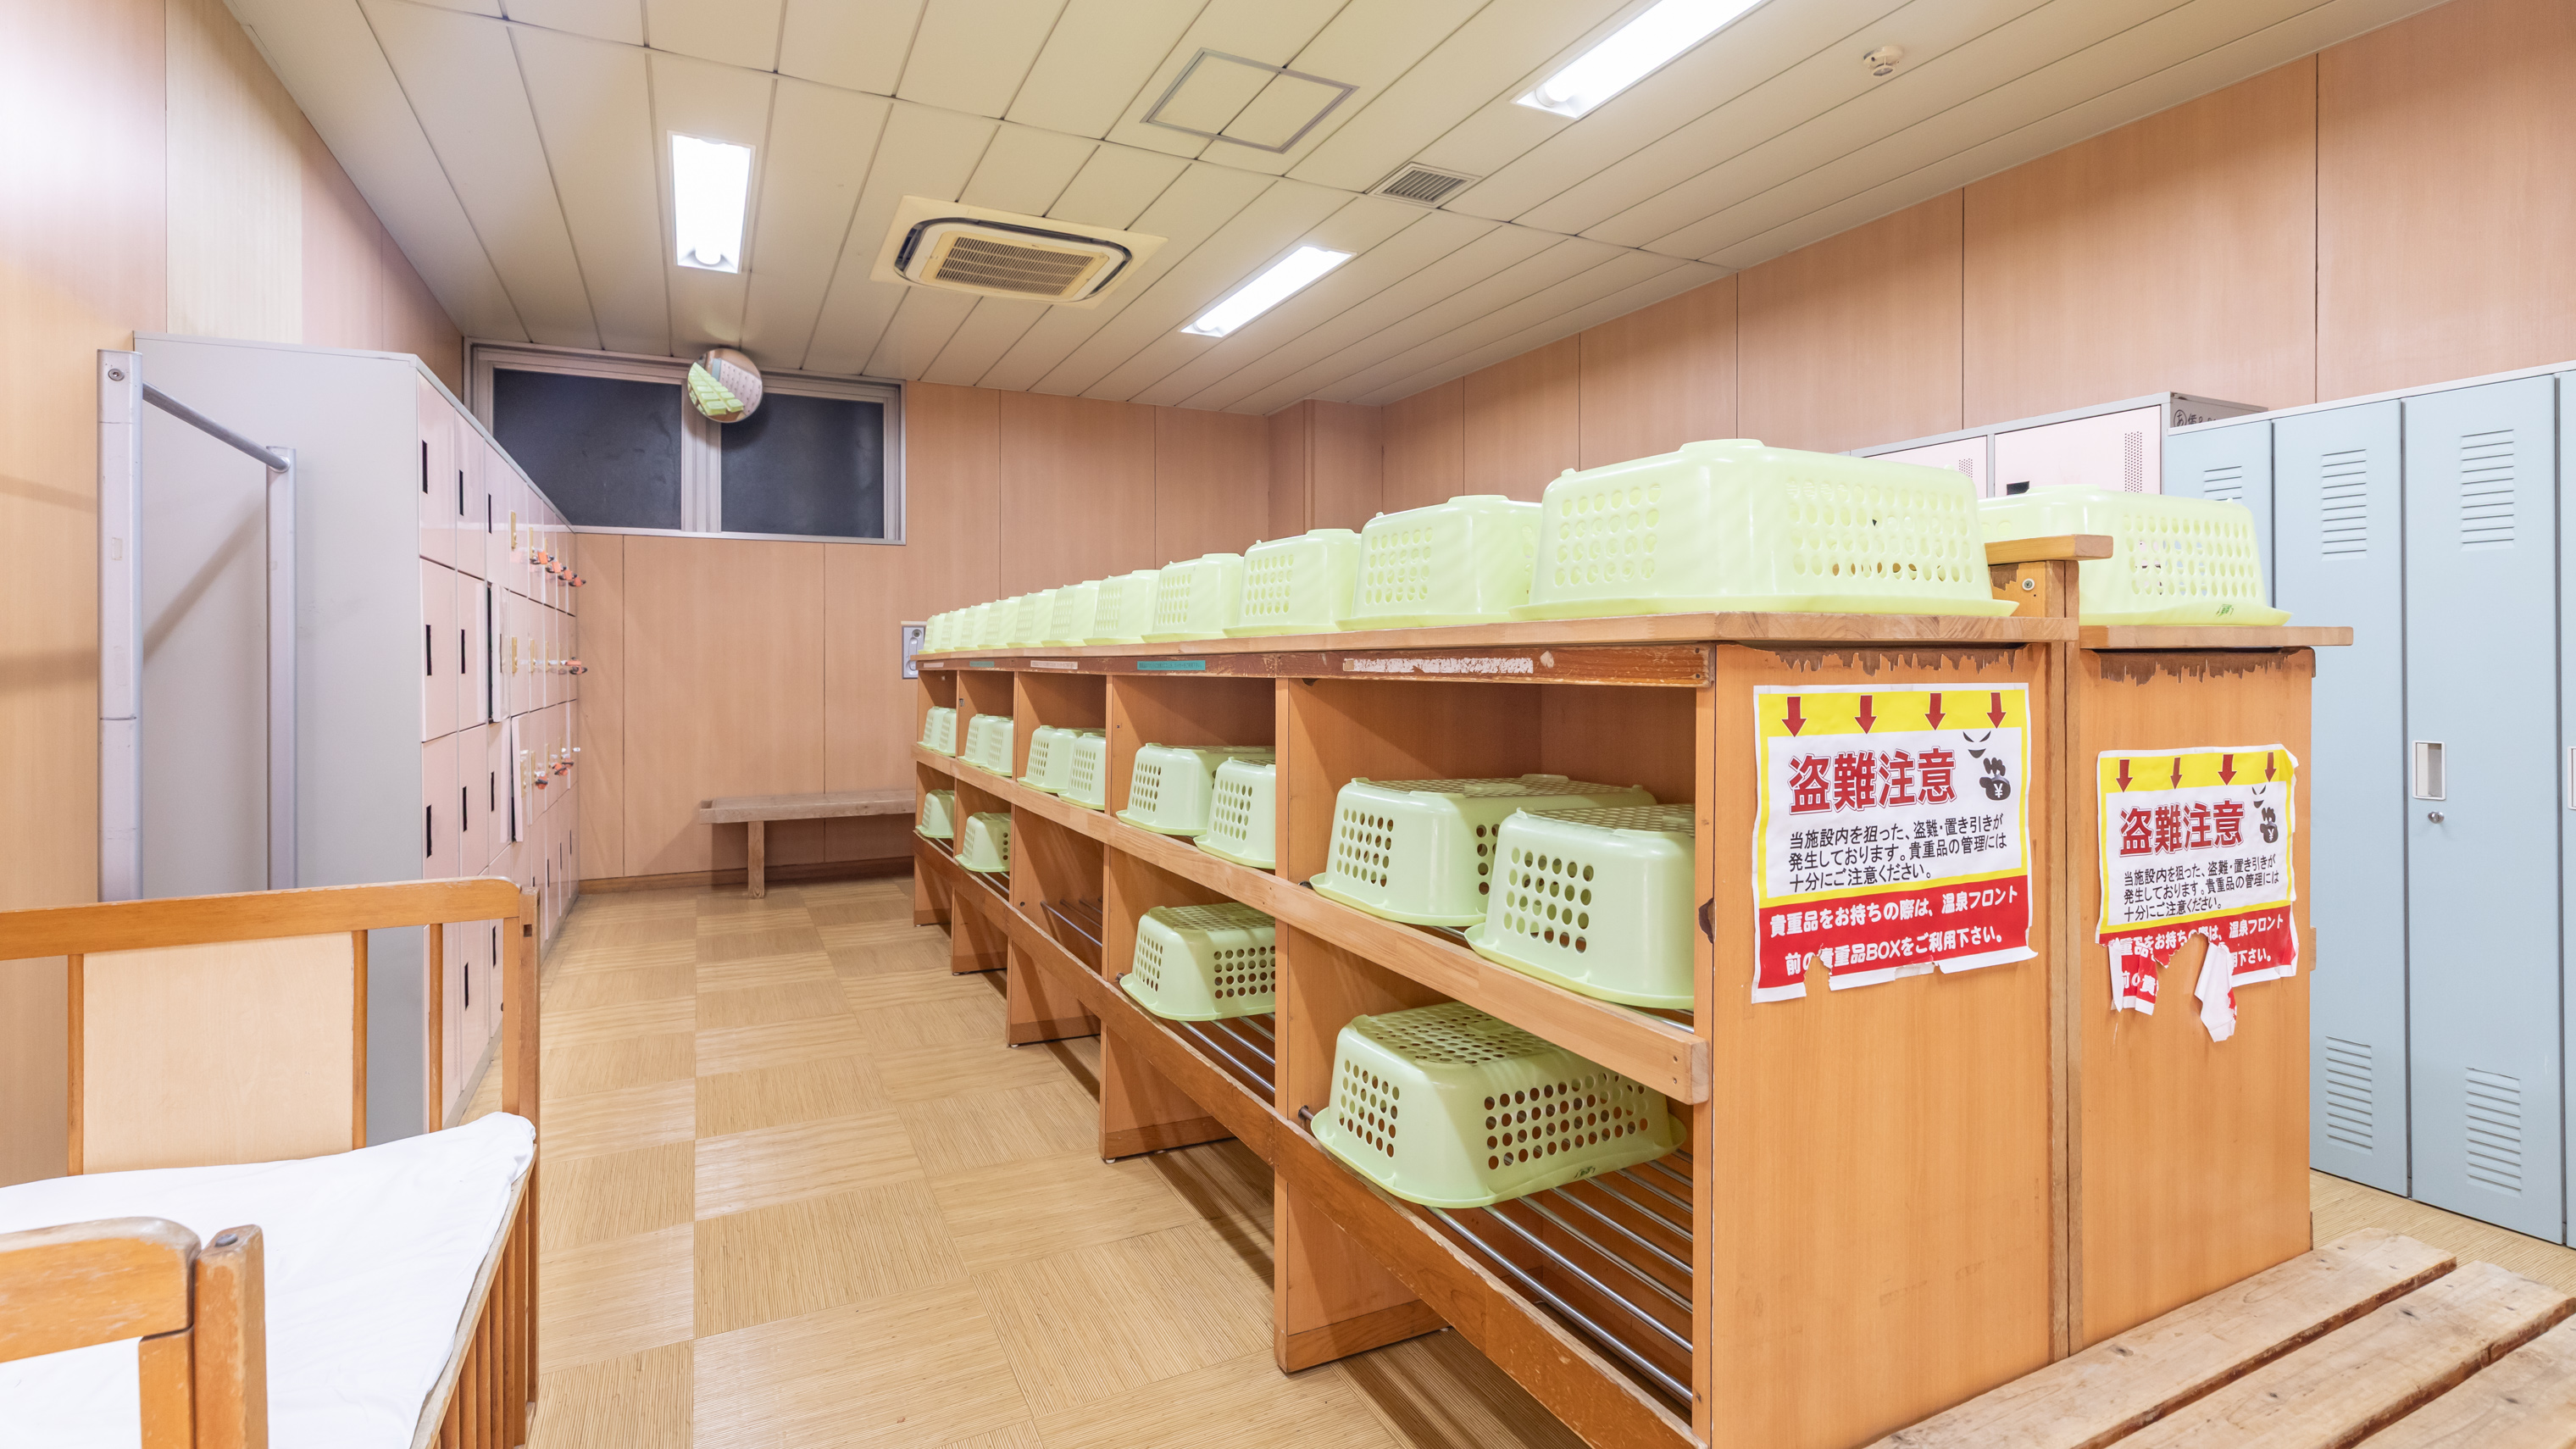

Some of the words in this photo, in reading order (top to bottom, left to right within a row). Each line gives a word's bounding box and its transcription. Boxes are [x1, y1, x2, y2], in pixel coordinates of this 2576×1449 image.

[1788, 747, 1957, 815] 盗難注意
[2119, 799, 2245, 857] 盗難注意
[1788, 832, 2007, 873] 発生しております。貴重品の管理には
[1790, 861, 1932, 893] 十分にご注意ください。
[2124, 897, 2222, 923] 十分にご注意ください。
